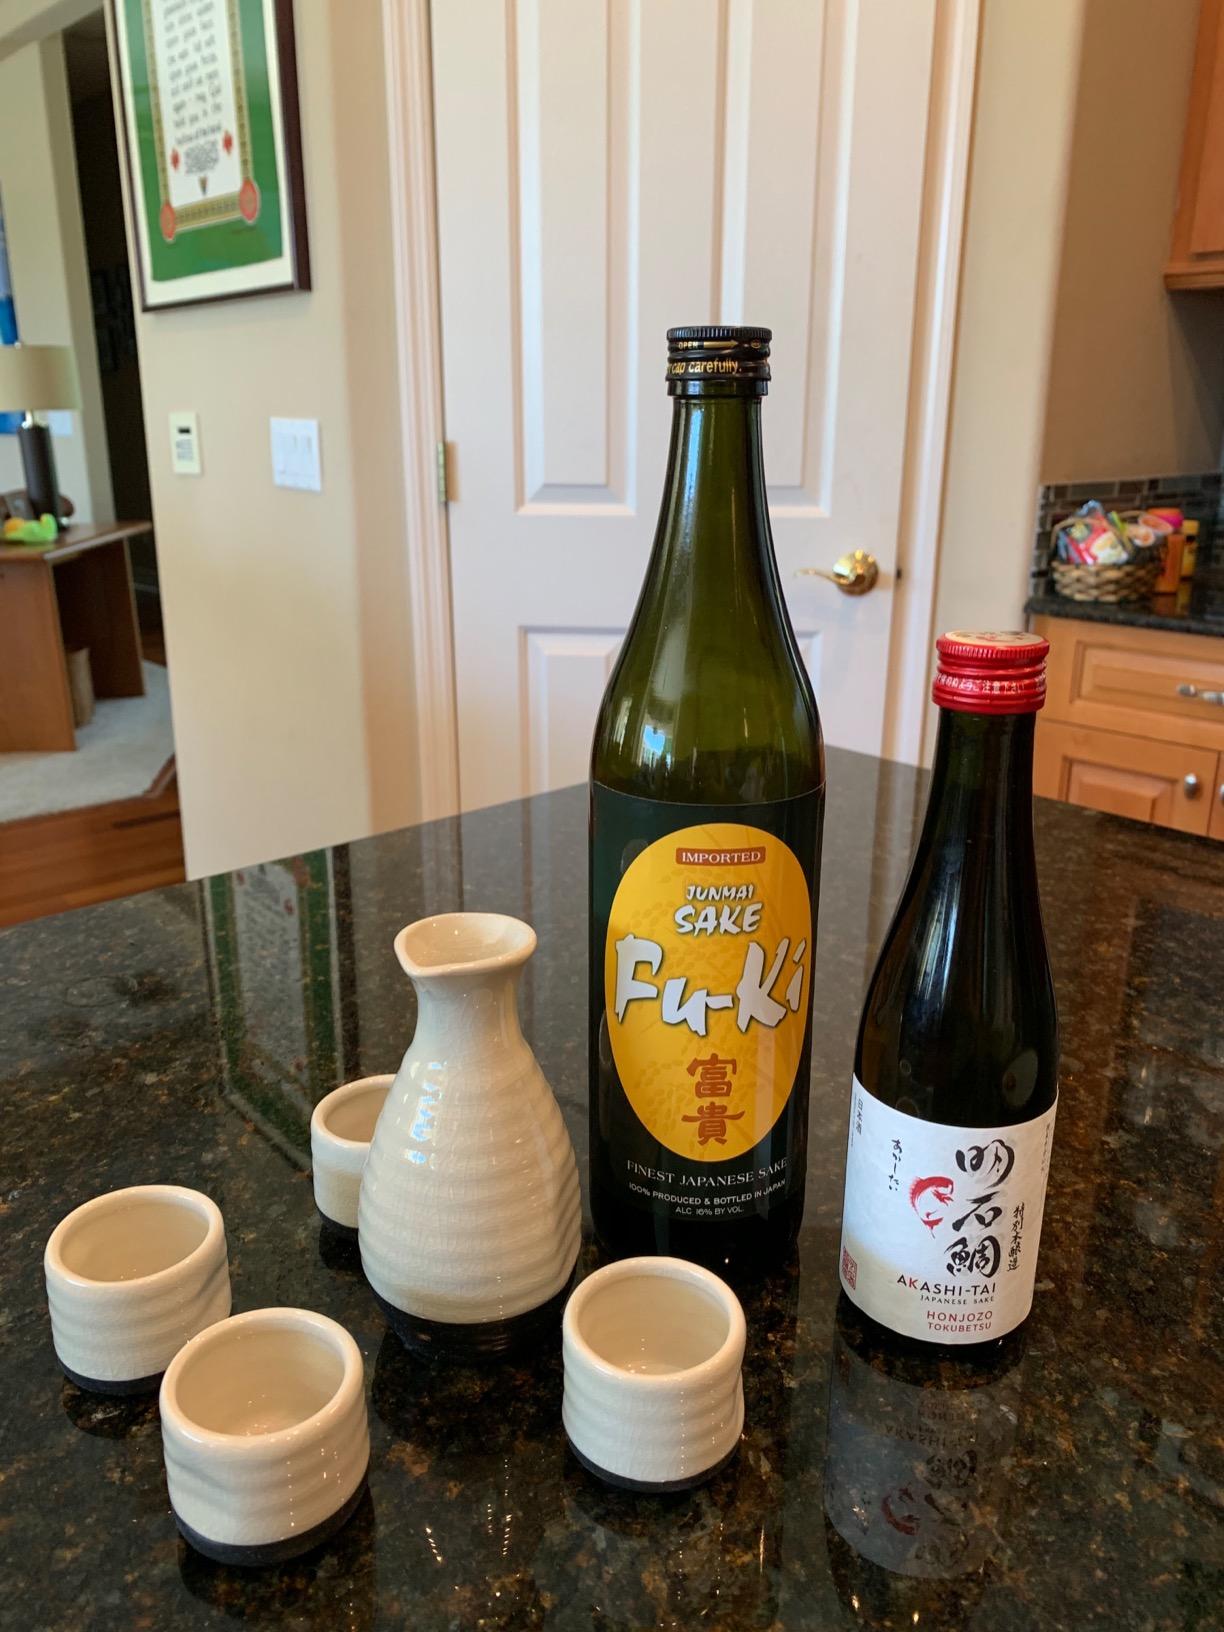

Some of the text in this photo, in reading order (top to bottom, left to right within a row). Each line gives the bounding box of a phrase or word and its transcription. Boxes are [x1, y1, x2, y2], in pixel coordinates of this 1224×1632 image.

[678, 341, 699, 349] OPEN
[688, 358, 742, 375] carefully.
[681, 851, 761, 863] IMPORTED
[686, 884, 754, 900] JUNMAI
[674, 902, 763, 936] SAKE
[615, 934, 807, 1036] Fu-Ki
[681, 1053, 745, 1146] 富貴
[627, 1157, 788, 1188] FINEST JAPANESE SAKE
[629, 1182, 651, 1197] 100%
[652, 1190, 702, 1205] PRODUCED
[714, 1193, 752, 1205] BOTTLED
[754, 1190, 762, 1198] IN
[763, 1180, 786, 1195] JAPAN
[715, 1207, 726, 1215] BY
[897, 1274, 996, 1296] AKASHI-TAI
[921, 1295, 994, 1304] JAPANESE SAKE
[927, 1310, 993, 1322] HONJOZO
[928, 1321, 992, 1332] TOKUBETSU
